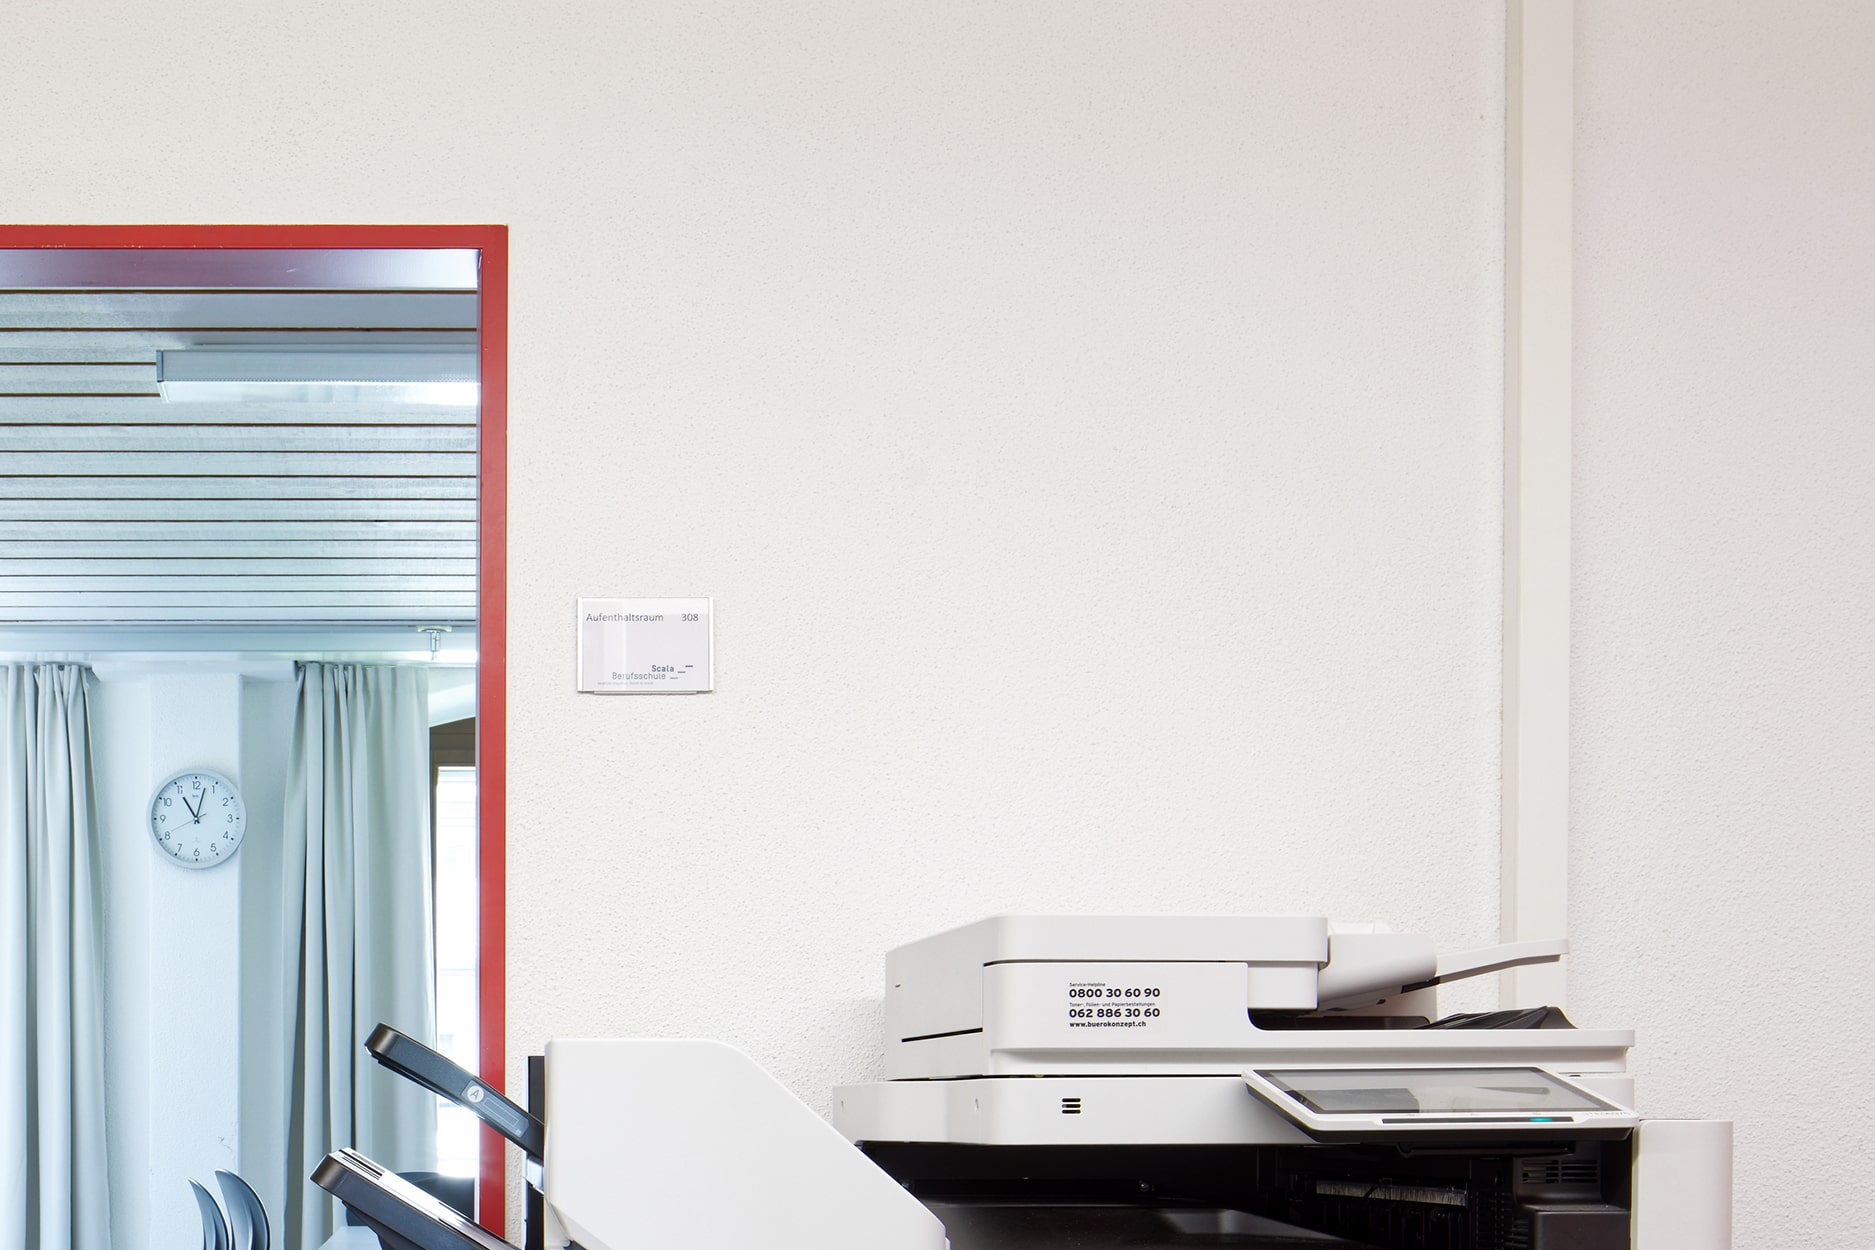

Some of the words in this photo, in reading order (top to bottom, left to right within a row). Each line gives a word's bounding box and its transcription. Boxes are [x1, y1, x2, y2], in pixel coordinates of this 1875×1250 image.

[585, 613, 664, 622] Aufenthaltsraum
[681, 613, 699, 622] 308
[651, 664, 675, 673] Scala
[611, 672, 666, 680] Berufsschule
[177, 785, 183, 795] 11
[192, 781, 201, 790] 12
[163, 798, 172, 807] 10
[222, 798, 229, 807] 2
[160, 814, 166, 824] 9
[227, 814, 233, 823] 3
[164, 831, 171, 840] 8
[222, 831, 229, 840] 4
[177, 843, 183, 852] 7
[210, 843, 217, 852] 5
[193, 848, 200, 857] 6
[1069, 988, 1102, 998] 0800
[1106, 988, 1122, 998] 30
[1125, 988, 1141, 998] 60
[1144, 987, 1161, 998] 90
[1069, 1008, 1093, 1018] 062
[1097, 1008, 1122, 1018] 886
[1125, 1008, 1141, 1018] 30
[1144, 1008, 1161, 1018] 60
[470, 1089, 480, 1100] A
